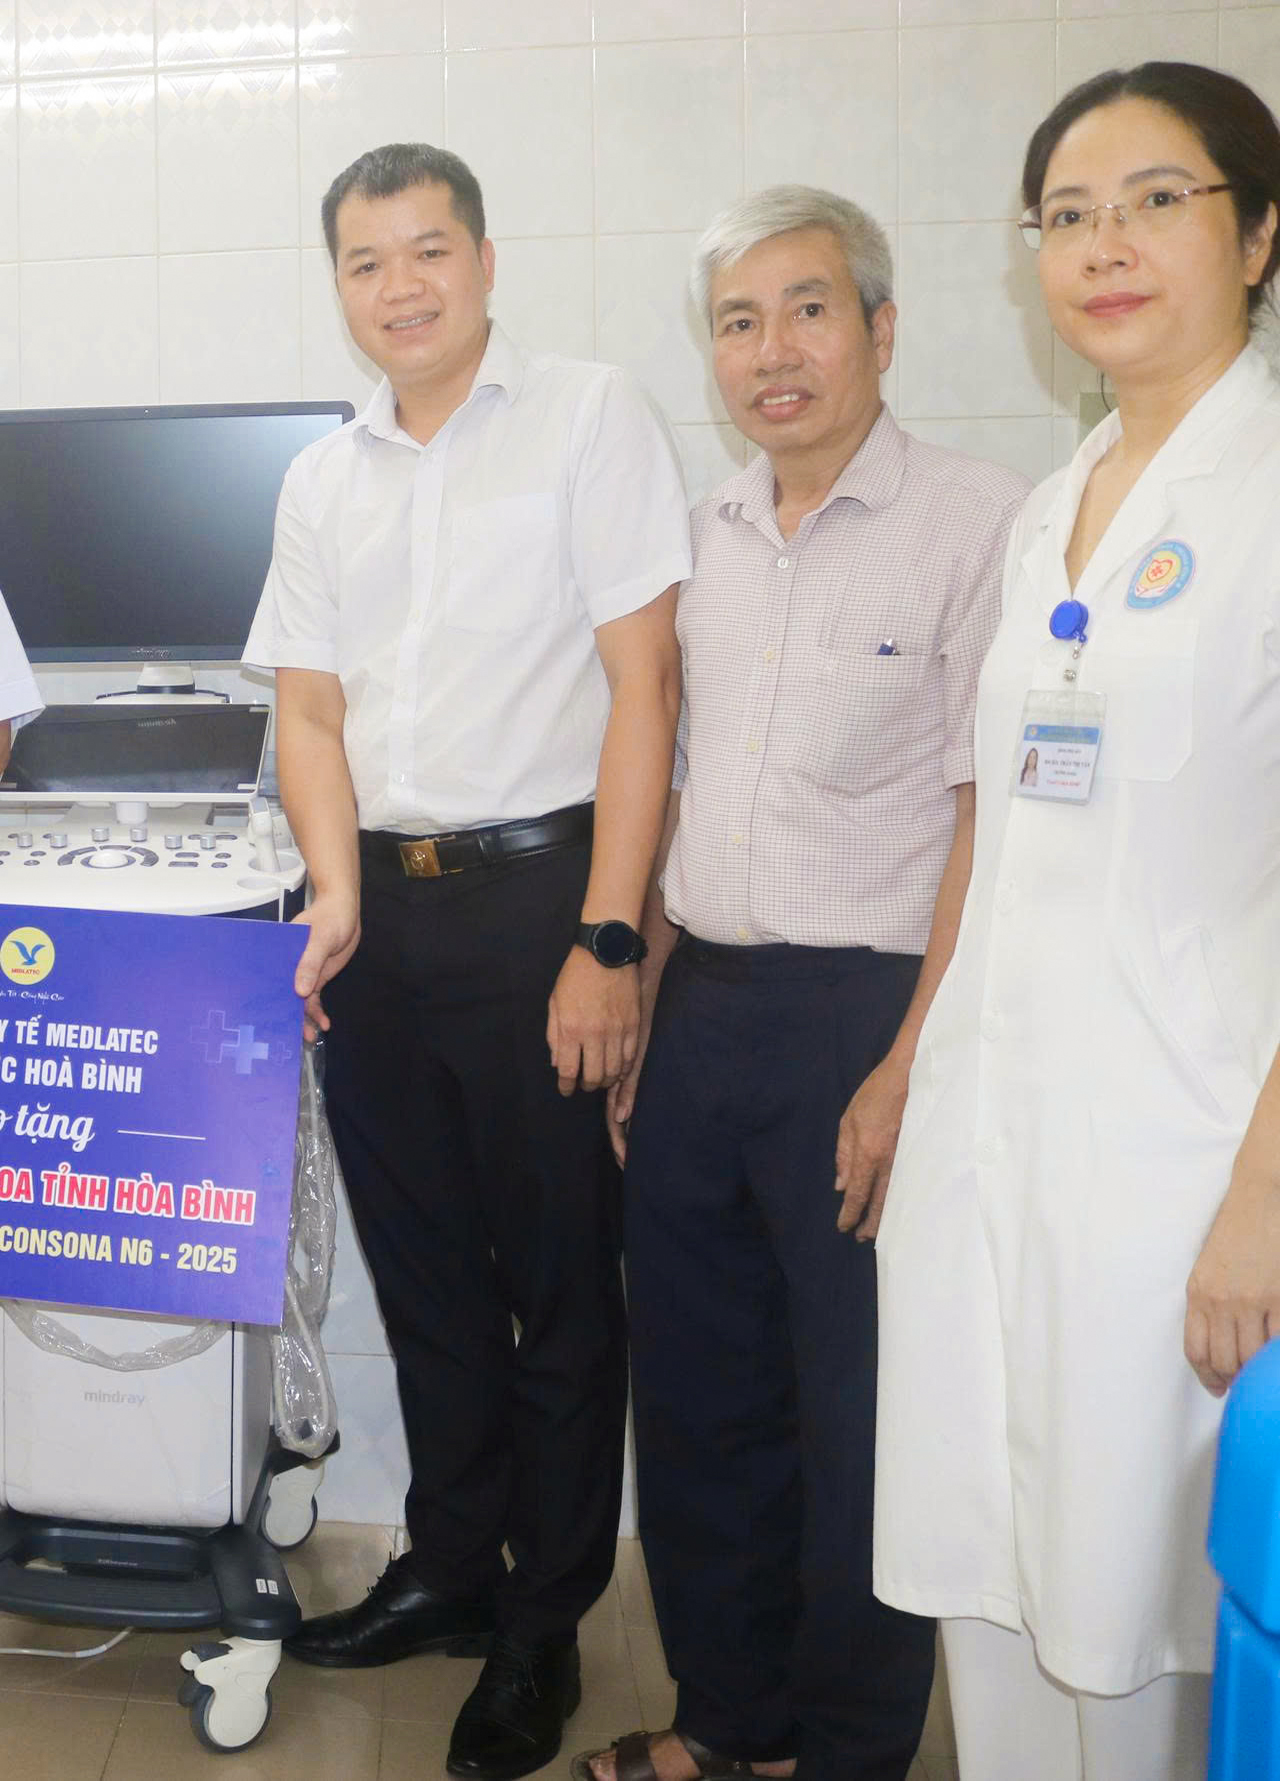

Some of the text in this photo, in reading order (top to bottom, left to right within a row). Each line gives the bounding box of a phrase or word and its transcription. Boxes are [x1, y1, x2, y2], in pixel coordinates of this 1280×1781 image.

[15, 1014, 43, 1045] TẾ
[45, 1022, 159, 1055] MEDLATEC
[24, 1055, 73, 1089] HOÀ
[81, 1058, 142, 1094] BÌNH
[13, 1102, 96, 1153] tặng
[41, 1161, 109, 1211] TỈNH
[113, 1172, 175, 1219] HÒA
[181, 1179, 256, 1226] BÌNH
[120, 1237, 153, 1266] N6
[160, 1251, 170, 1260] -
[177, 1243, 237, 1274] 2025
[84, 1390, 145, 1408] mindray
